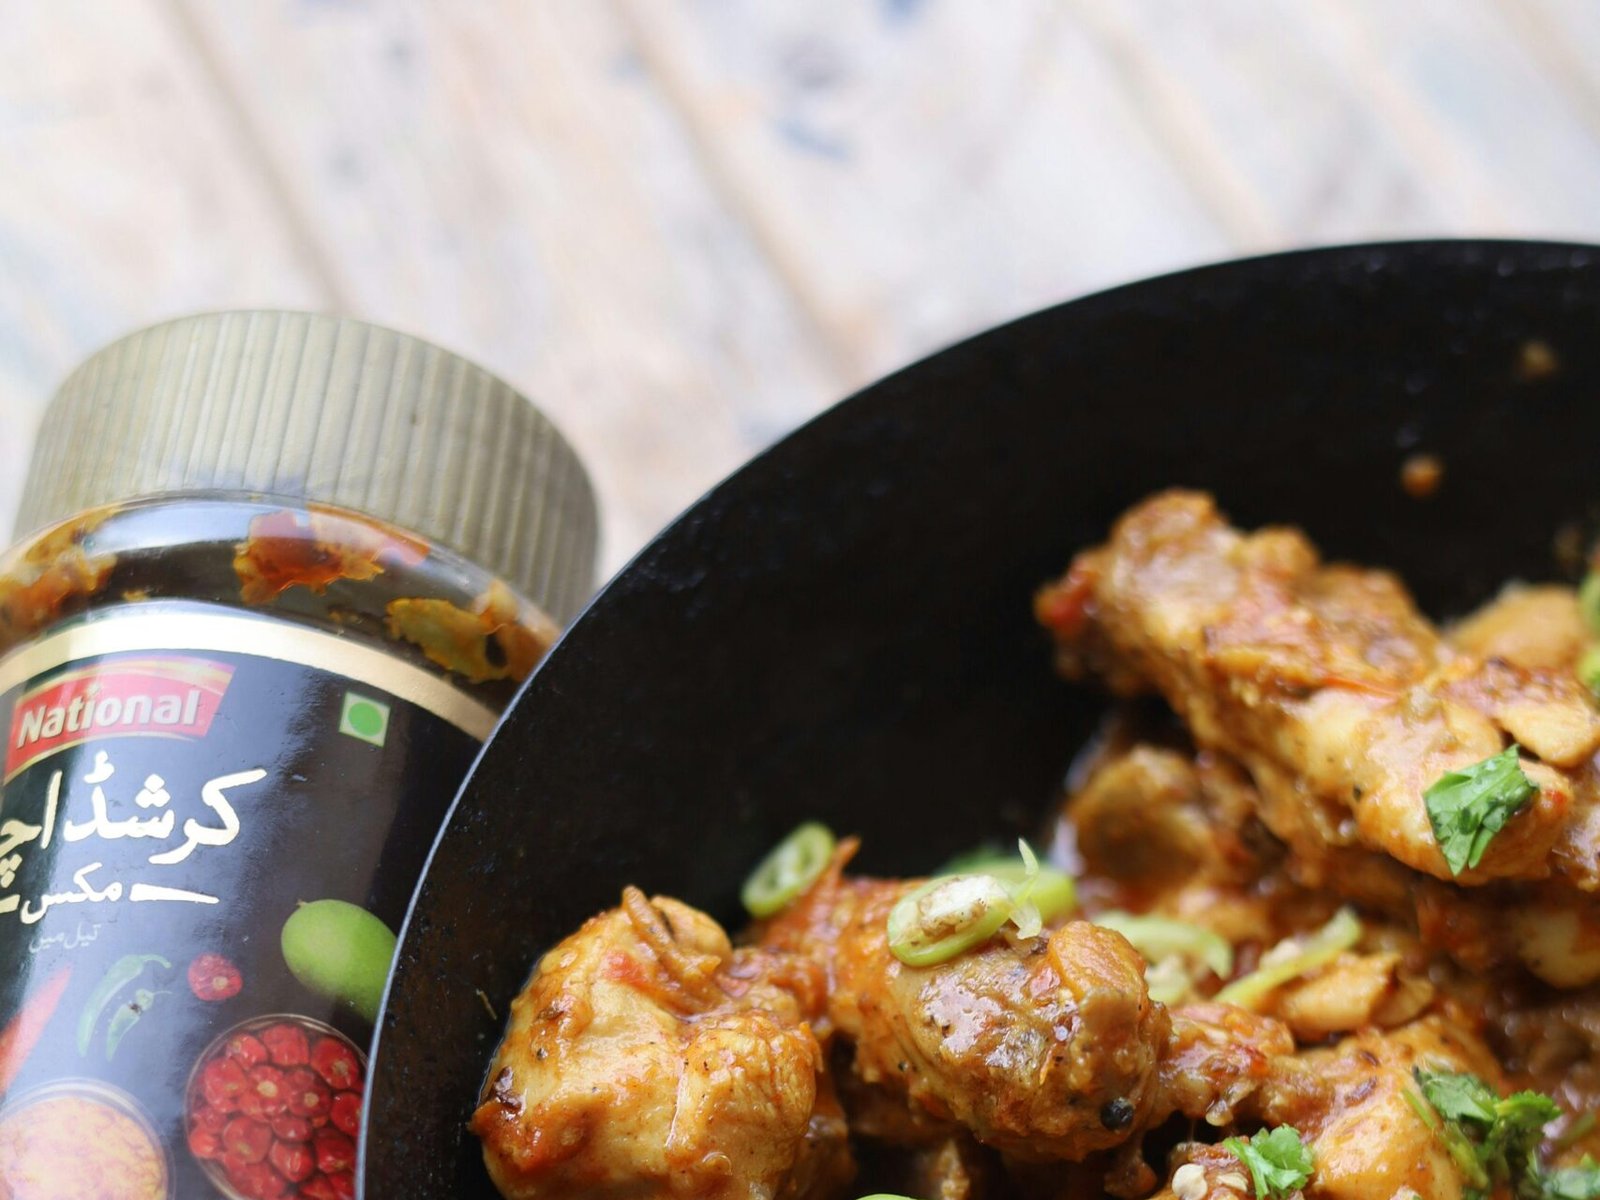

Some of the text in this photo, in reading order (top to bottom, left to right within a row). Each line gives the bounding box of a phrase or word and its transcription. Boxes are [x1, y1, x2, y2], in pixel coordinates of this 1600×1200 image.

[17, 686, 201, 749] National
[63, 750, 268, 865] کرشڈ
[19, 862, 123, 925] مکس
